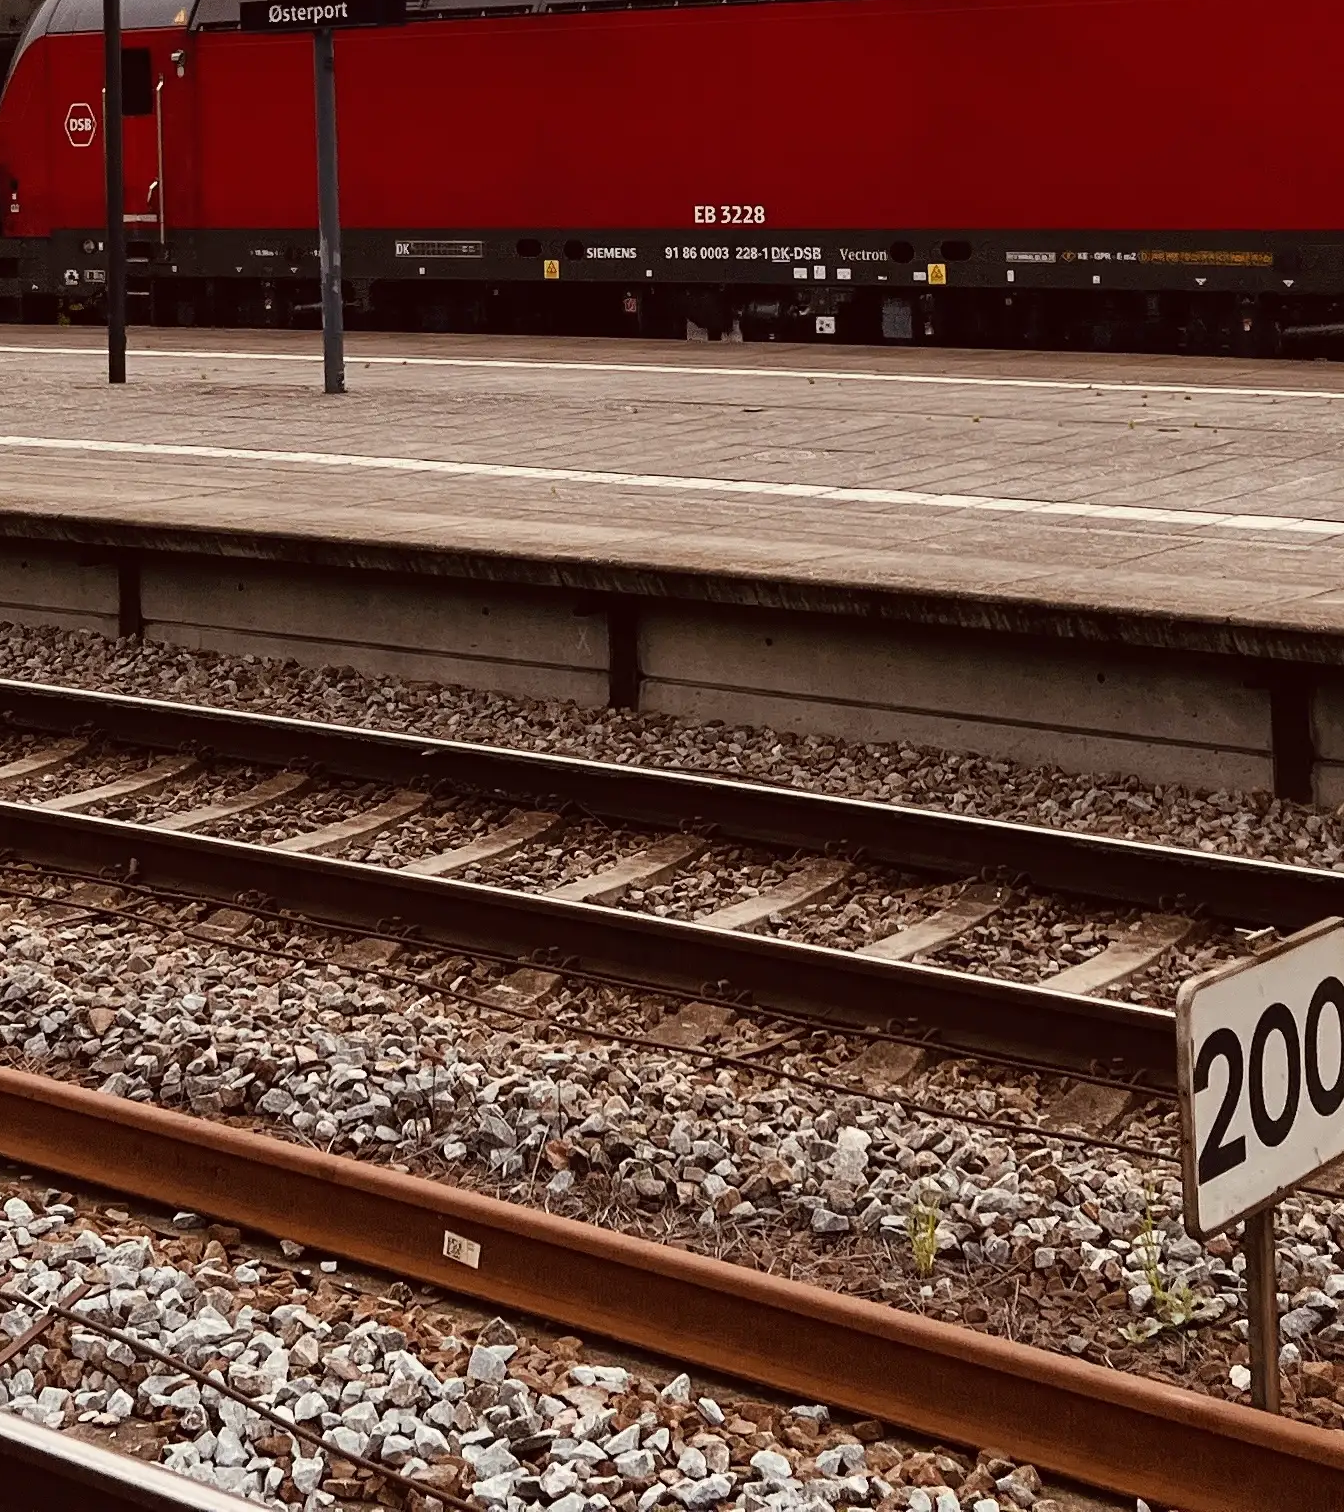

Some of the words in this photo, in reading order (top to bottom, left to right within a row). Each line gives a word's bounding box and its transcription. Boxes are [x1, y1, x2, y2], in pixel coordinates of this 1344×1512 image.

[268, 1, 348, 24] Østerport
[68, 118, 93, 132] DSB
[694, 205, 717, 224] EB
[720, 205, 766, 224] 3228
[586, 247, 637, 259] SIEMENS
[664, 246, 679, 259] 91
[682, 246, 698, 260] 86
[699, 246, 730, 260] 0003
[839, 248, 888, 262] Vectron
